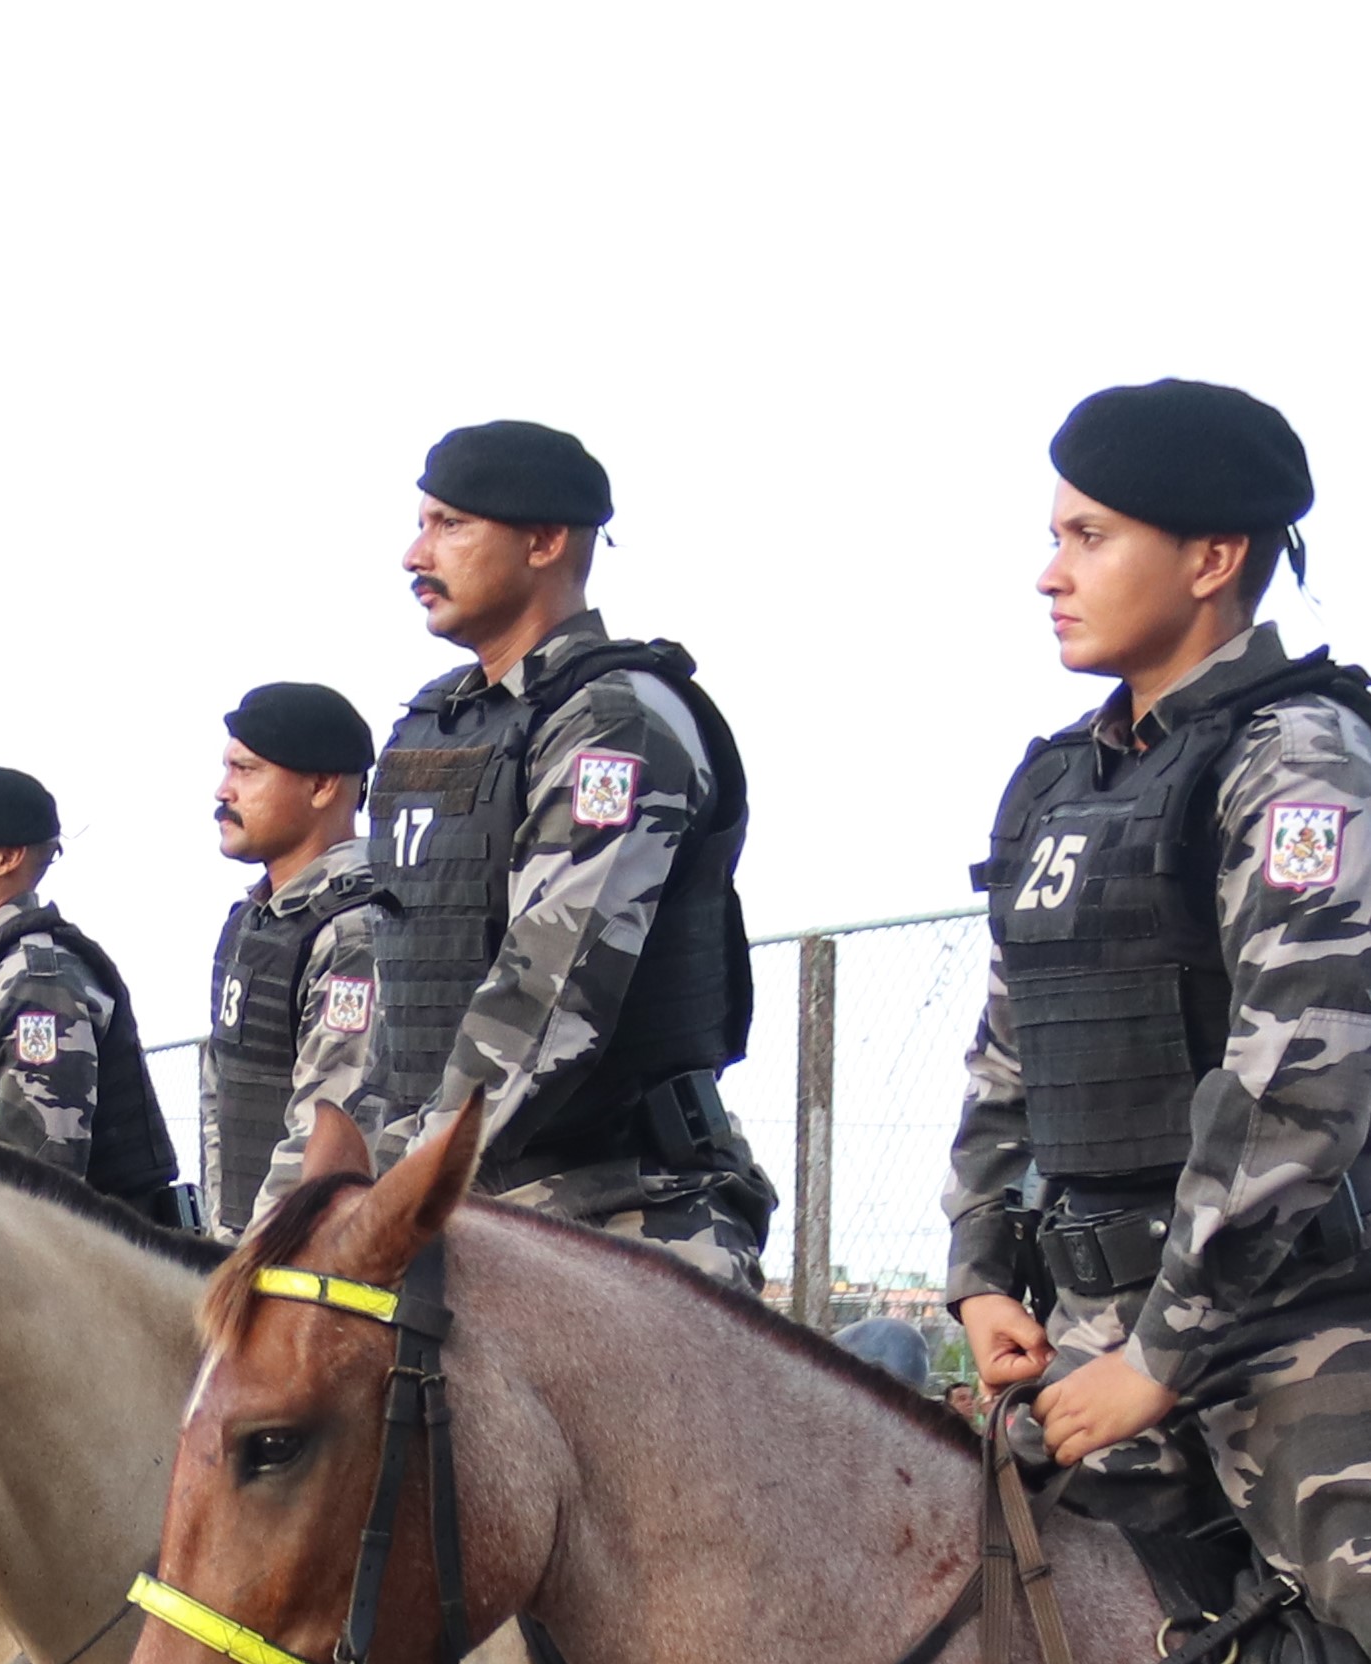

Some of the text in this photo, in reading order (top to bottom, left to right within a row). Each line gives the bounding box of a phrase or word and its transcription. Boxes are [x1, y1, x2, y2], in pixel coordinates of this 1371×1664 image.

[393, 808, 434, 868] 17
[1014, 834, 1088, 911] 25
[219, 974, 243, 1027] 13
